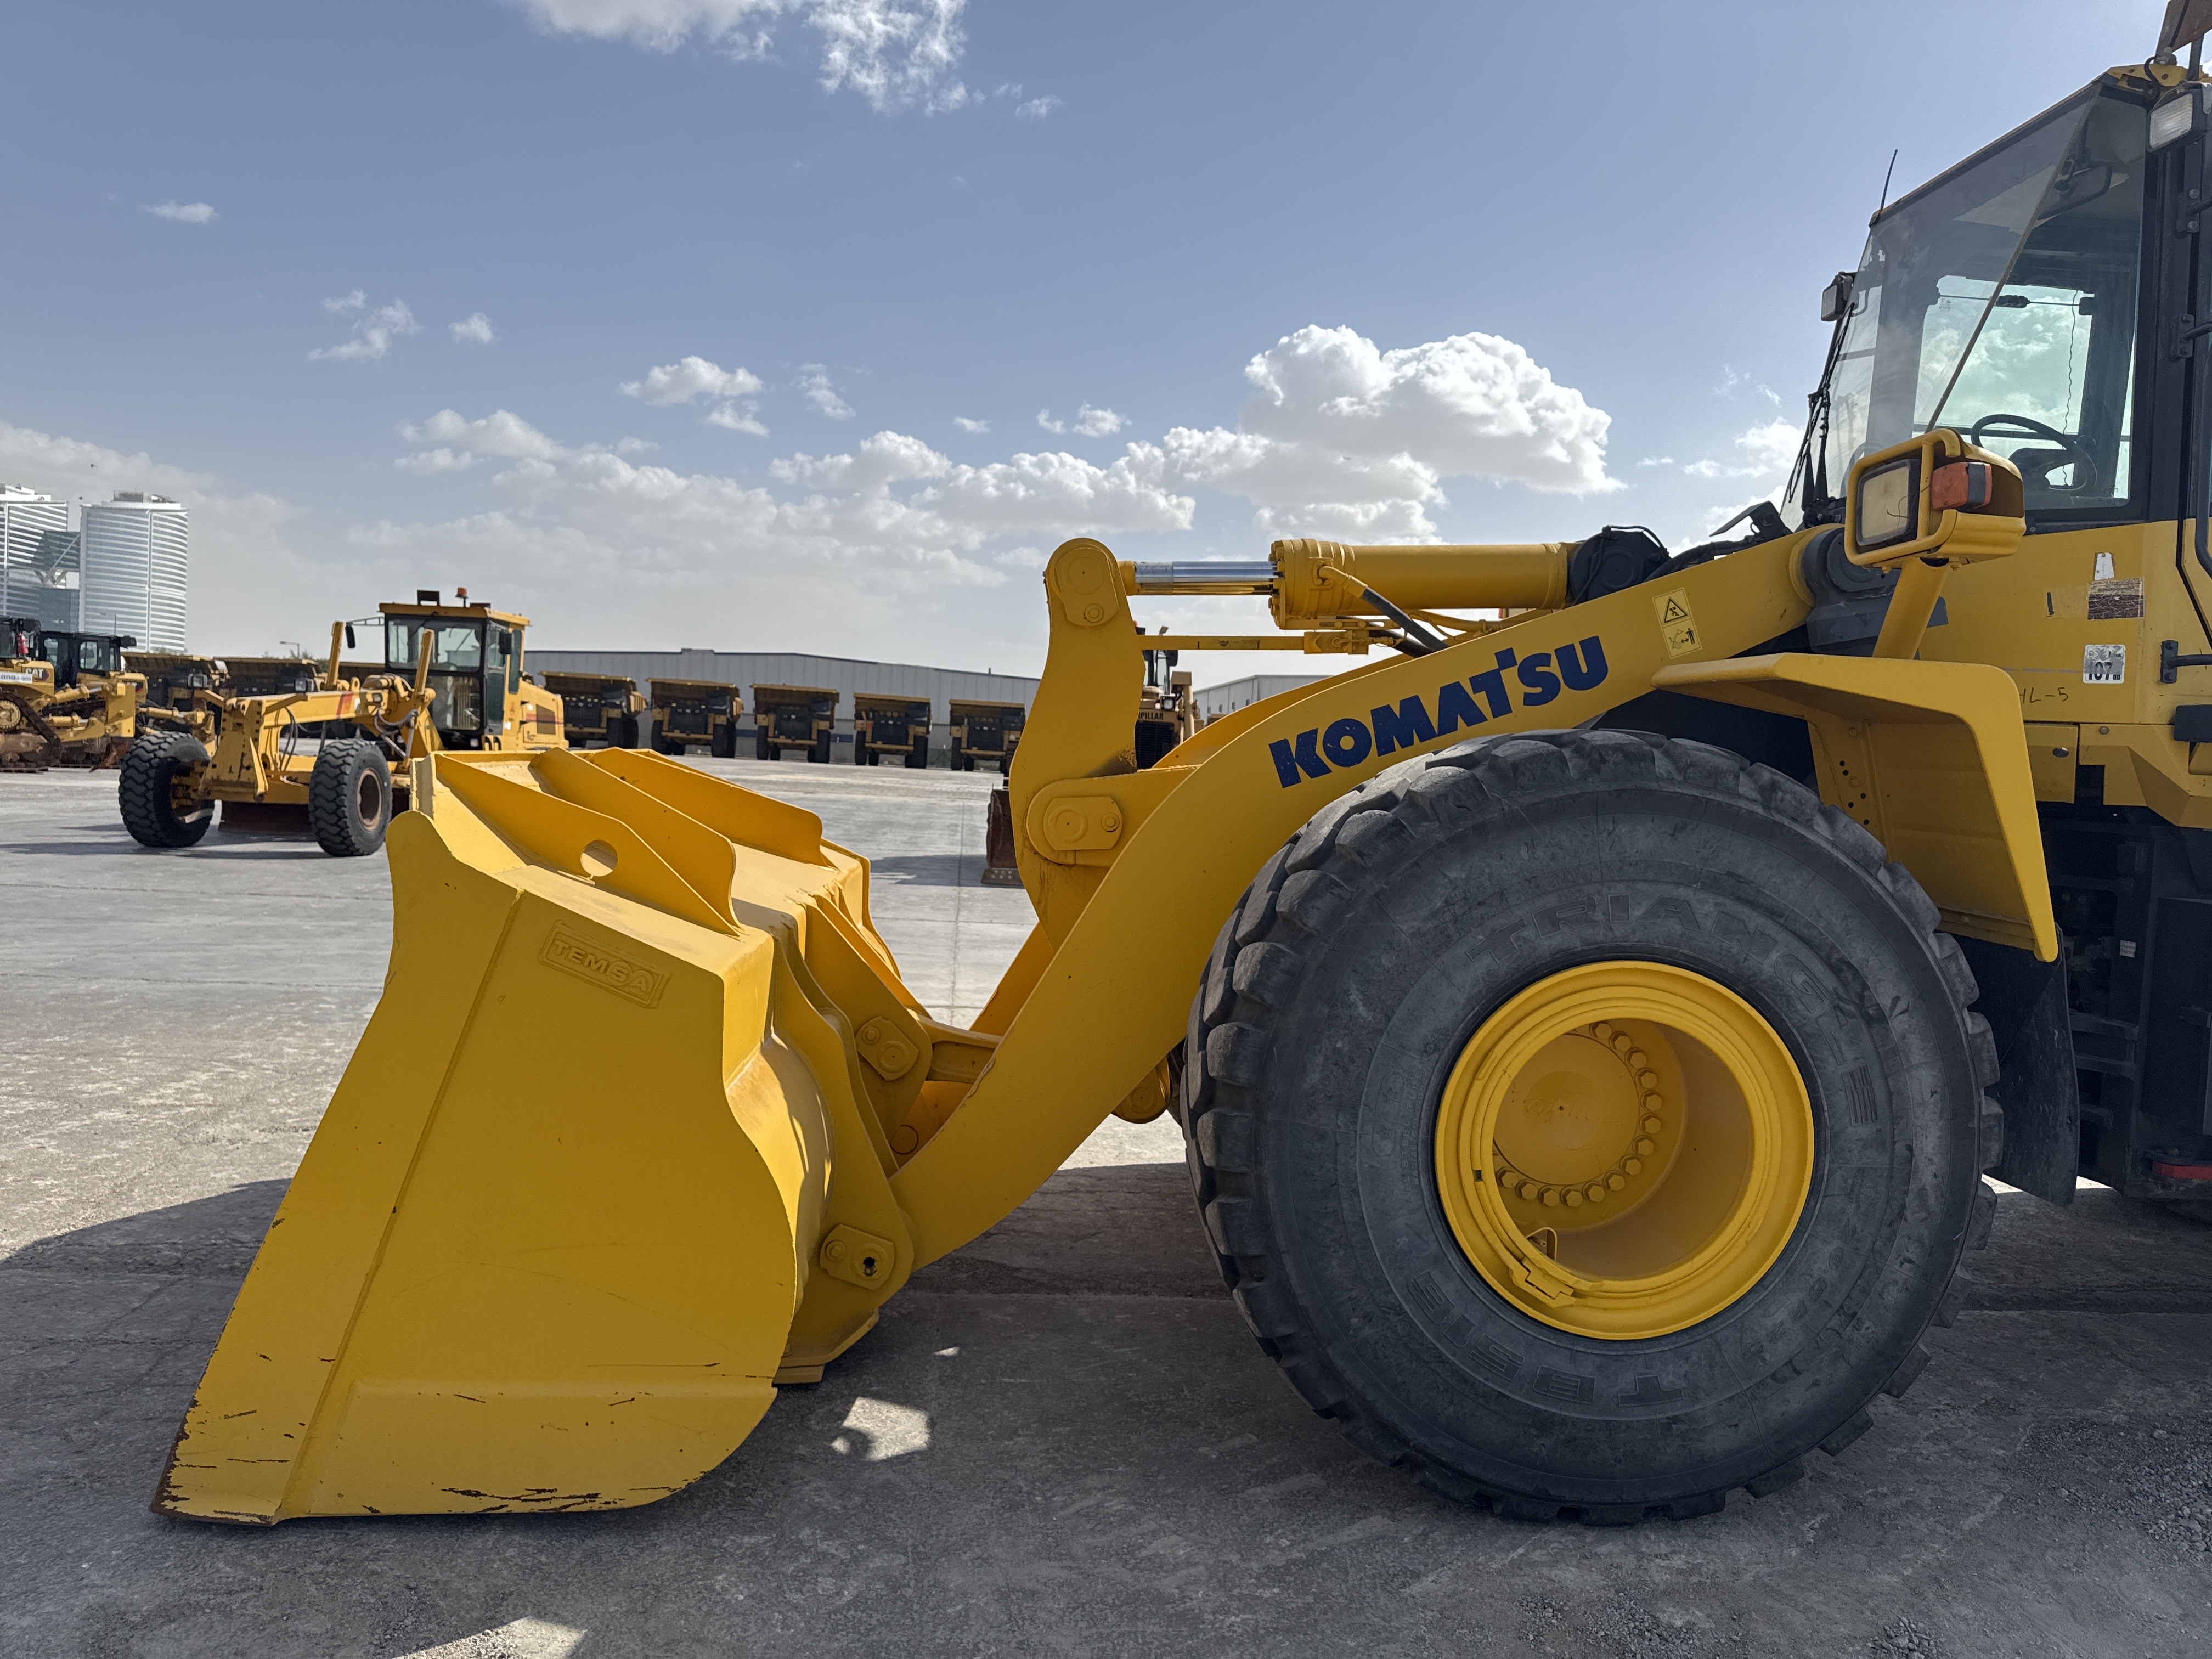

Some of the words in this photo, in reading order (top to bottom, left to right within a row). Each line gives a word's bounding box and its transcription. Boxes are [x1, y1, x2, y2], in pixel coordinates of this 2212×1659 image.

[1268, 635, 1609, 788] KOMATSU
[2089, 662, 2113, 680] 107
[552, 940, 655, 993] TEMSA
[1465, 894, 1878, 1126] TRIANGLE
